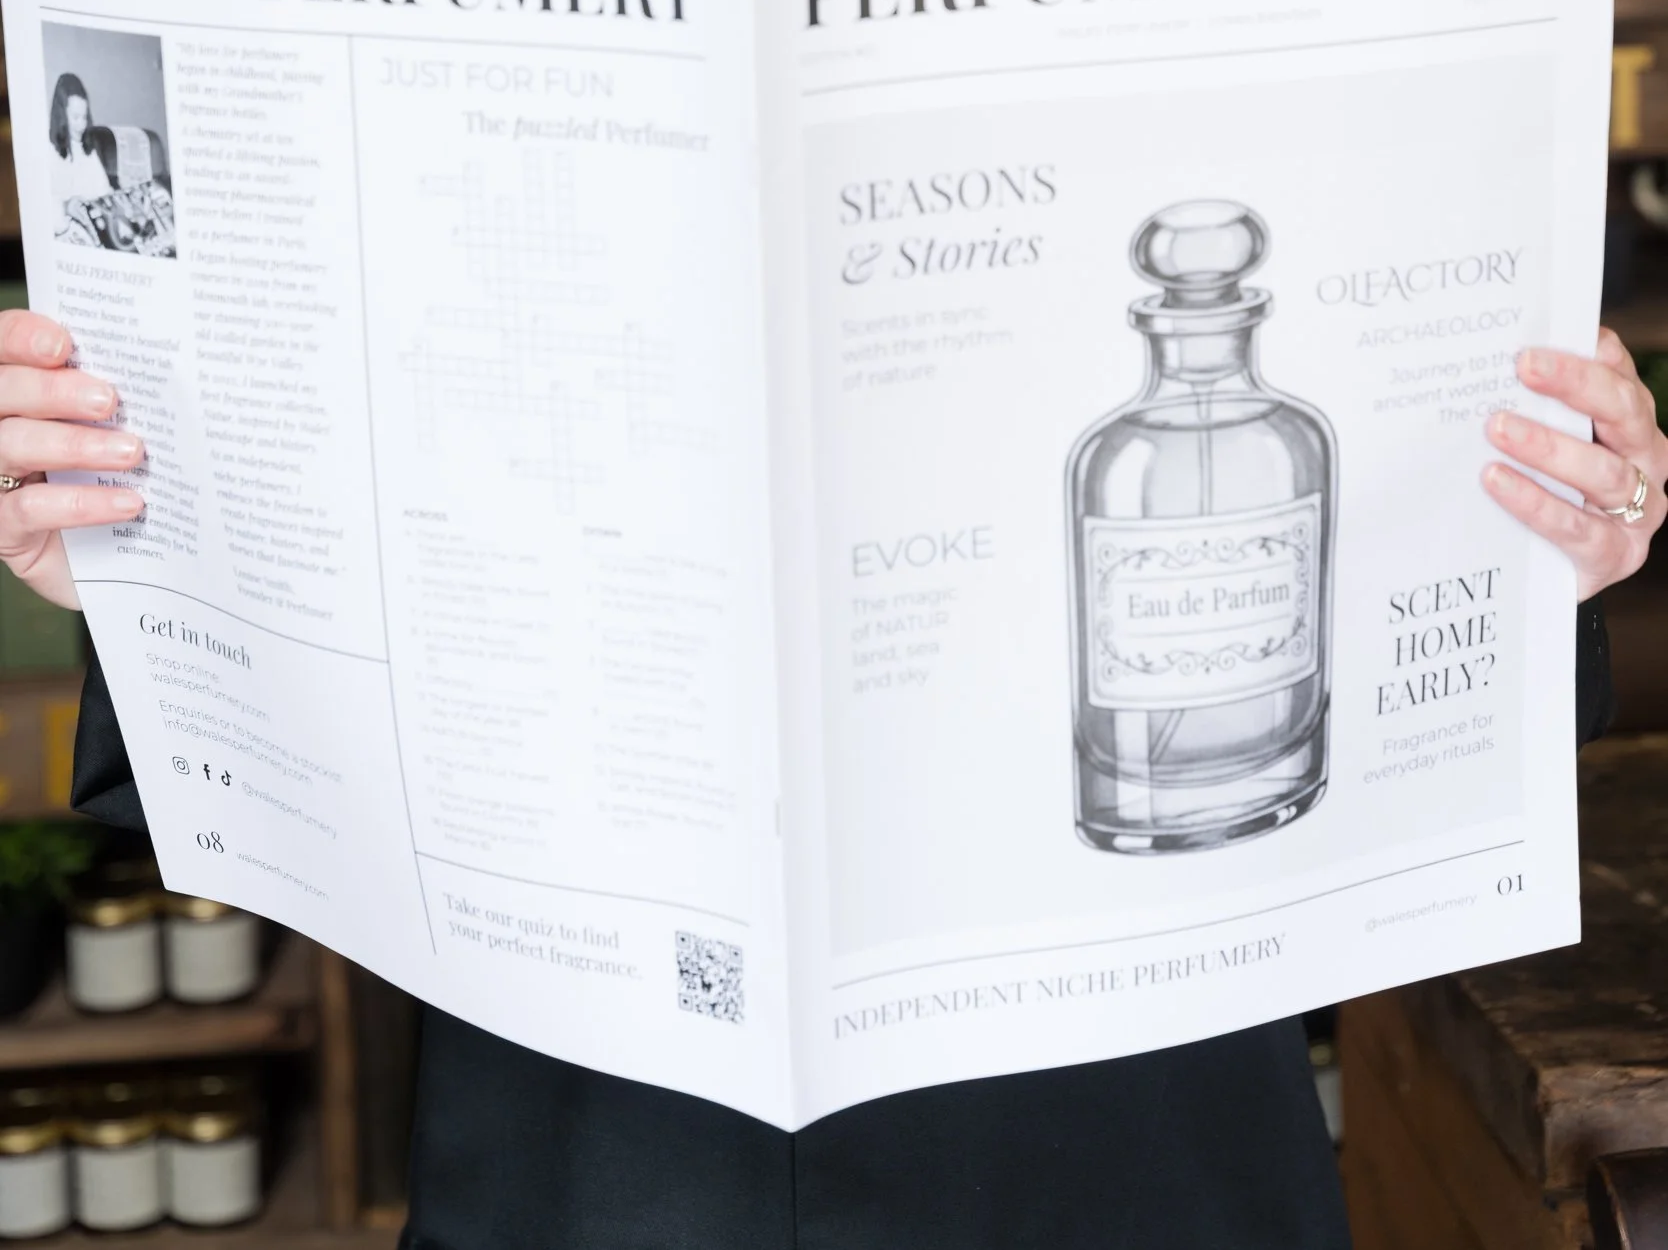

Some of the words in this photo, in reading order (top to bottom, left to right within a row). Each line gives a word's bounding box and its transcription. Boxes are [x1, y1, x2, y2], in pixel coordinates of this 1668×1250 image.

[378, 55, 457, 92] JUST
[464, 61, 536, 95] FOR
[543, 65, 616, 100] FUN
[460, 109, 508, 137] The
[838, 162, 1058, 228] SEASONS
[839, 241, 884, 287] &
[890, 225, 1045, 281] Stories
[1315, 245, 1526, 308] OLFACTORY
[1355, 304, 1523, 350] ARCHAEOLOGY
[1448, 373, 1500, 401] world
[852, 524, 997, 580] EVOKE
[1126, 593, 1171, 620] Eau
[1176, 587, 1205, 617] de
[1211, 579, 1291, 614] Parfum
[1388, 566, 1502, 627] SCENT
[139, 612, 177, 640] Get
[180, 620, 201, 648] in
[203, 630, 253, 671] touch
[145, 652, 182, 672] Shop
[1393, 610, 1498, 670] HOME
[1375, 651, 1497, 719] EARLY?
[1362, 748, 1440, 786] everyday
[1441, 734, 1497, 763] rituals
[1381, 719, 1470, 757] Fragrance
[1471, 711, 1496, 733] for
[195, 830, 226, 855] 08
[442, 891, 482, 920] Take
[484, 906, 514, 929] our
[516, 912, 556, 941] quiz
[558, 920, 579, 941] to
[580, 923, 621, 952] find
[447, 917, 484, 944] your
[486, 930, 548, 964] perfect
[831, 978, 1030, 1041] INDEPENDENT
[1033, 967, 1127, 1003] NICHE
[1131, 931, 1290, 989] PERFUMERY
